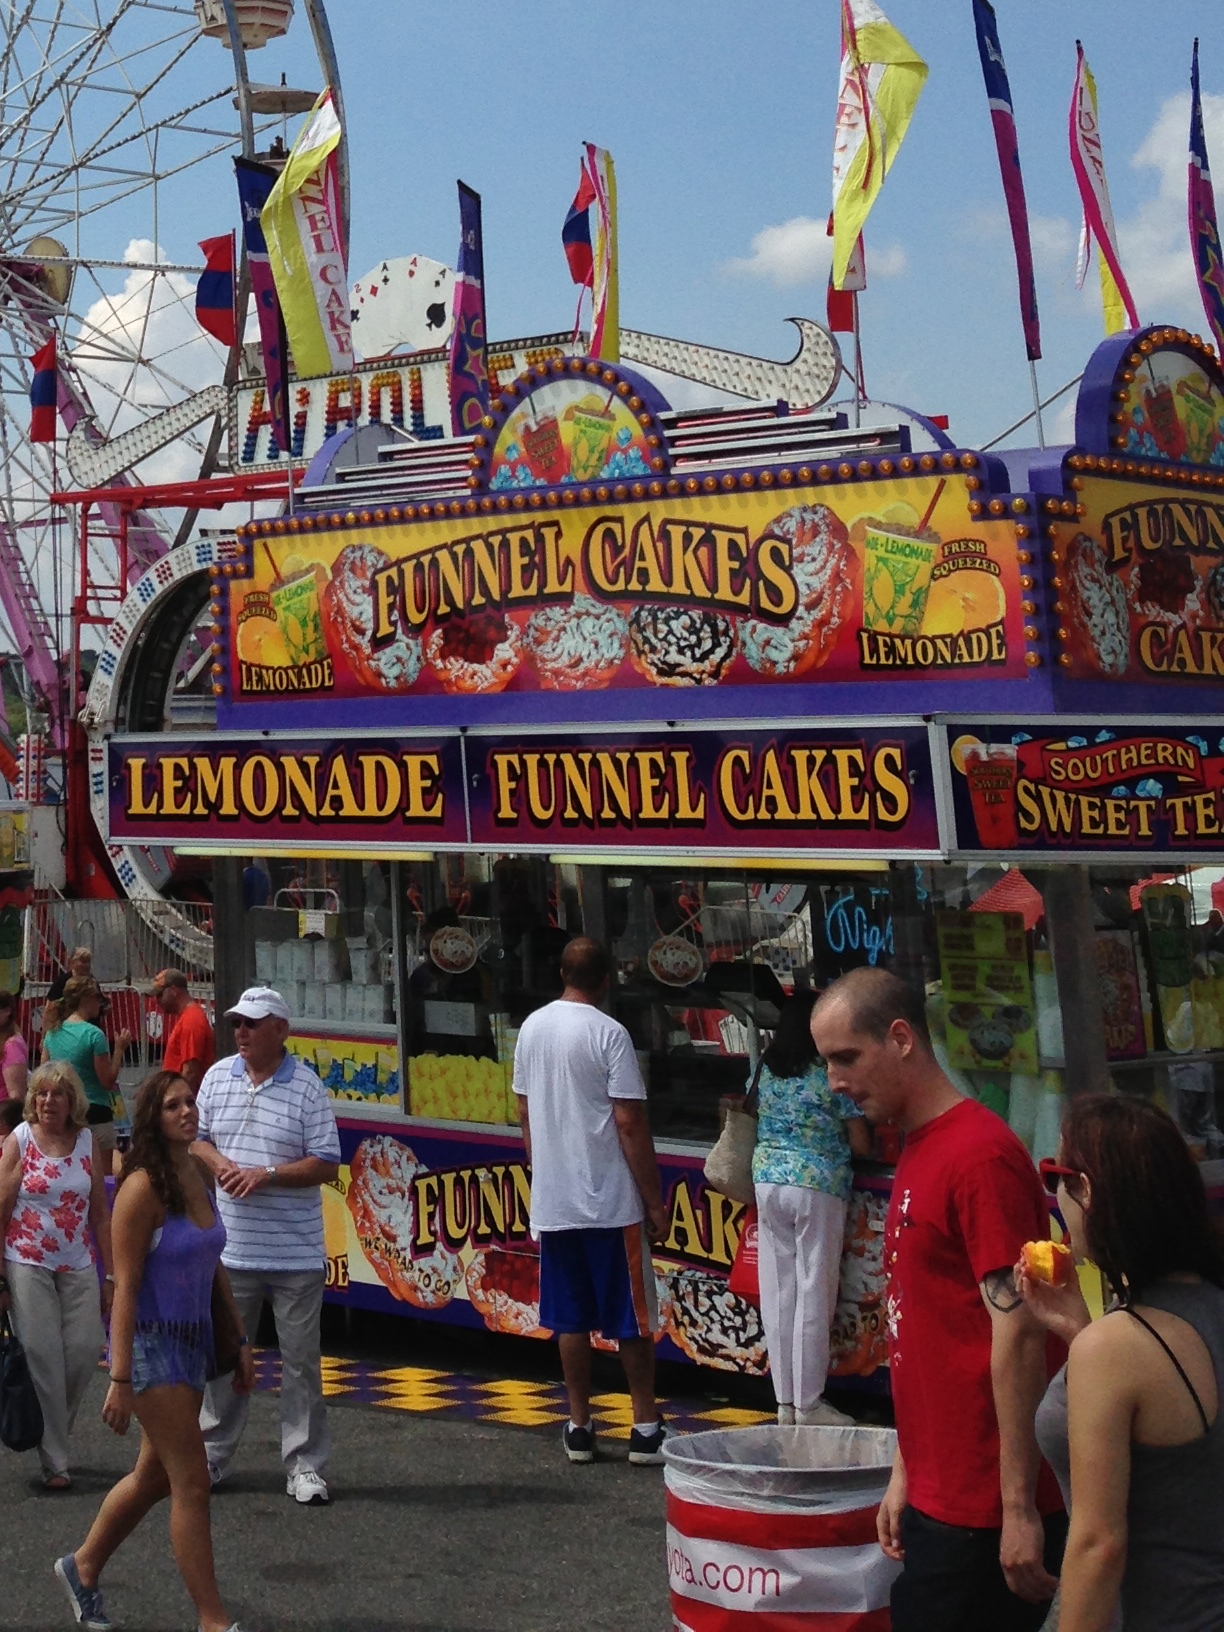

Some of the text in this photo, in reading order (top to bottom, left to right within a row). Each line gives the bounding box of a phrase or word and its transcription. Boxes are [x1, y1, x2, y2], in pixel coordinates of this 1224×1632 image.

[319, 264, 353, 355] CAKE
[943, 540, 987, 557] FRESH
[1108, 502, 1224, 563] FUNN
[374, 514, 798, 638] FUNNEL CAKES
[933, 558, 1001, 579] SQUEEZED
[860, 624, 1007, 666] LEMONADE
[1139, 625, 1224, 677] CAK
[241, 658, 334, 691] LEMONADE
[126, 753, 443, 819] LEMONADE
[496, 746, 910, 823] FUNNEL CAKES
[1049, 741, 1195, 782] SOUTHERN
[1016, 777, 1224, 837] SWEET TE
[414, 1163, 532, 1247] FUNN
[384, 1242, 415, 1274] WRAP
[416, 1268, 432, 1289] TO
